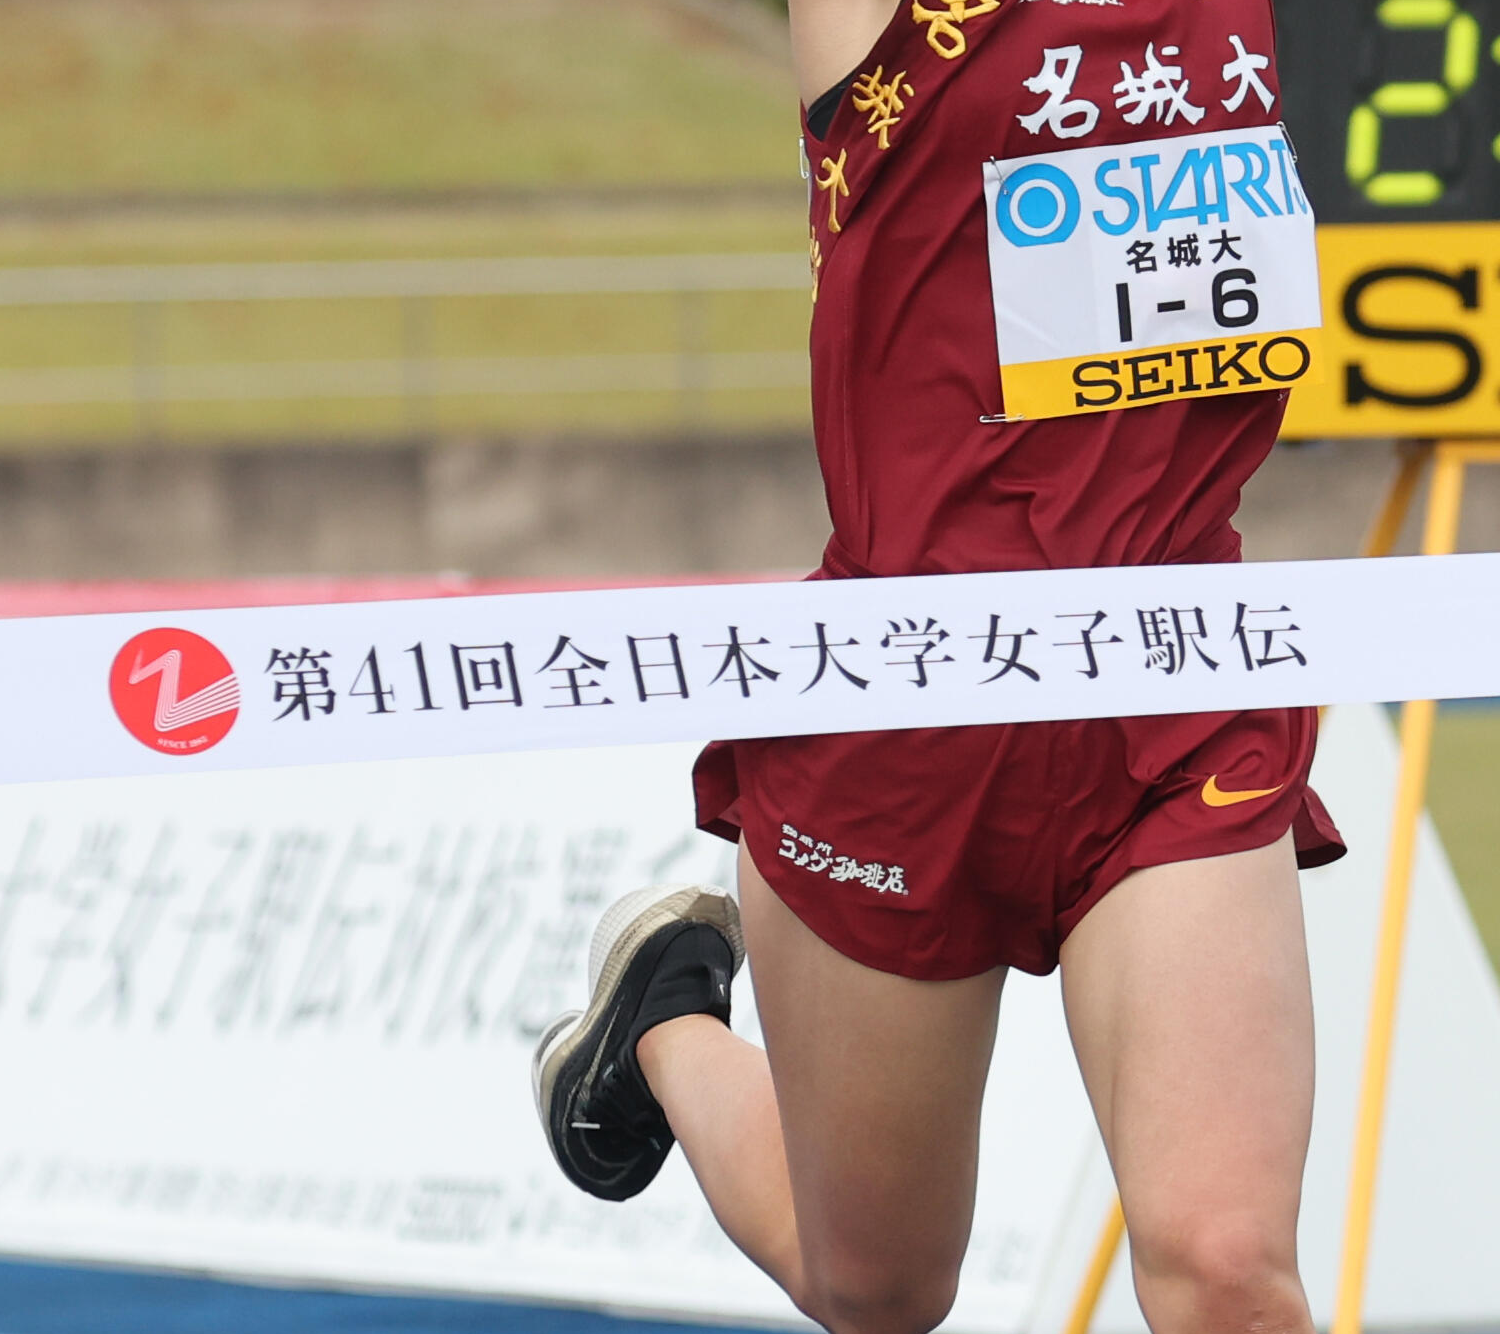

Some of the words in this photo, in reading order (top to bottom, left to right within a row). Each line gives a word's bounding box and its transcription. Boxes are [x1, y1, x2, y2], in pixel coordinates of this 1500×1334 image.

[1016, 35, 1276, 138] 名城大
[1126, 230, 1242, 273] 名城大
[1071, 336, 1311, 408] SEIKO
[263, 600, 1309, 725] 第41回全日本大学女子駅伝
